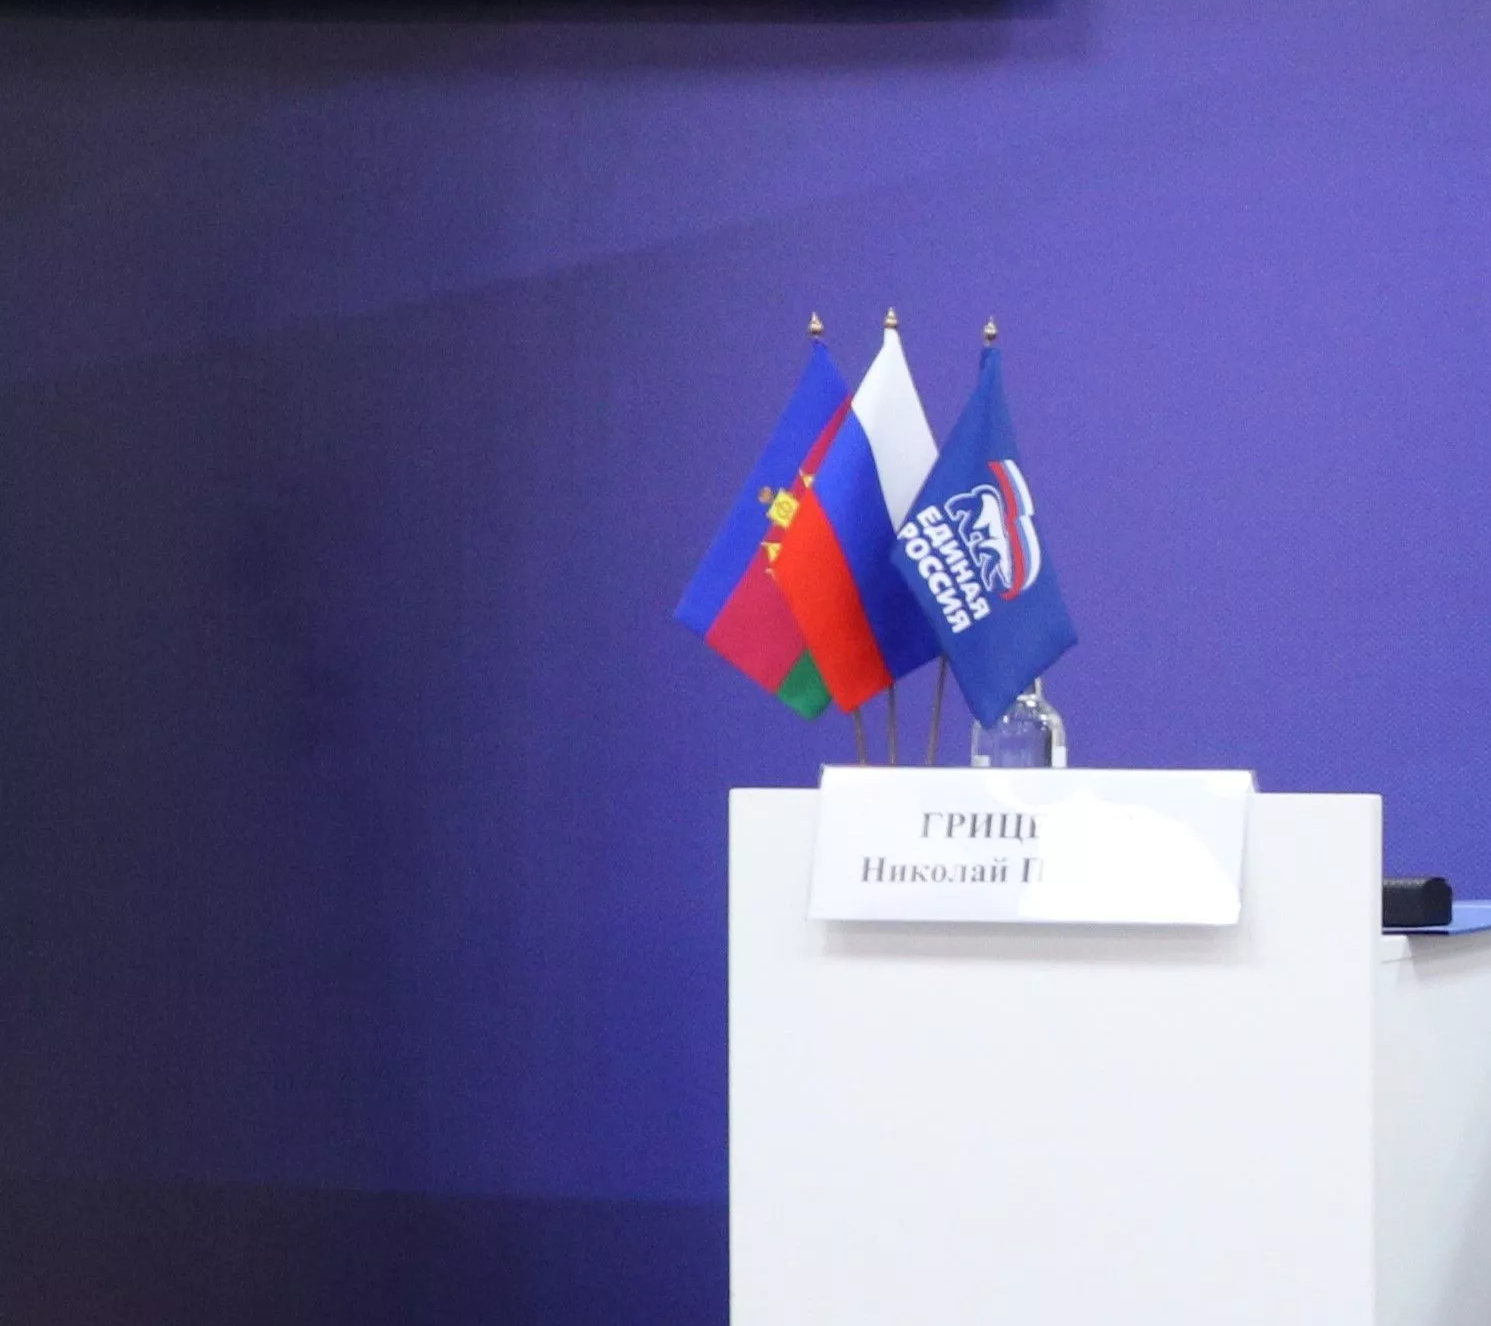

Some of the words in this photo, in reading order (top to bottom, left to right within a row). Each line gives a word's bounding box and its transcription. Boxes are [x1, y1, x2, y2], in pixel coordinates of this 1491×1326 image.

[896, 522, 972, 634] РОССИЯ
[916, 505, 991, 621] ЕДИНАЯ
[860, 856, 1010, 884] Николай
